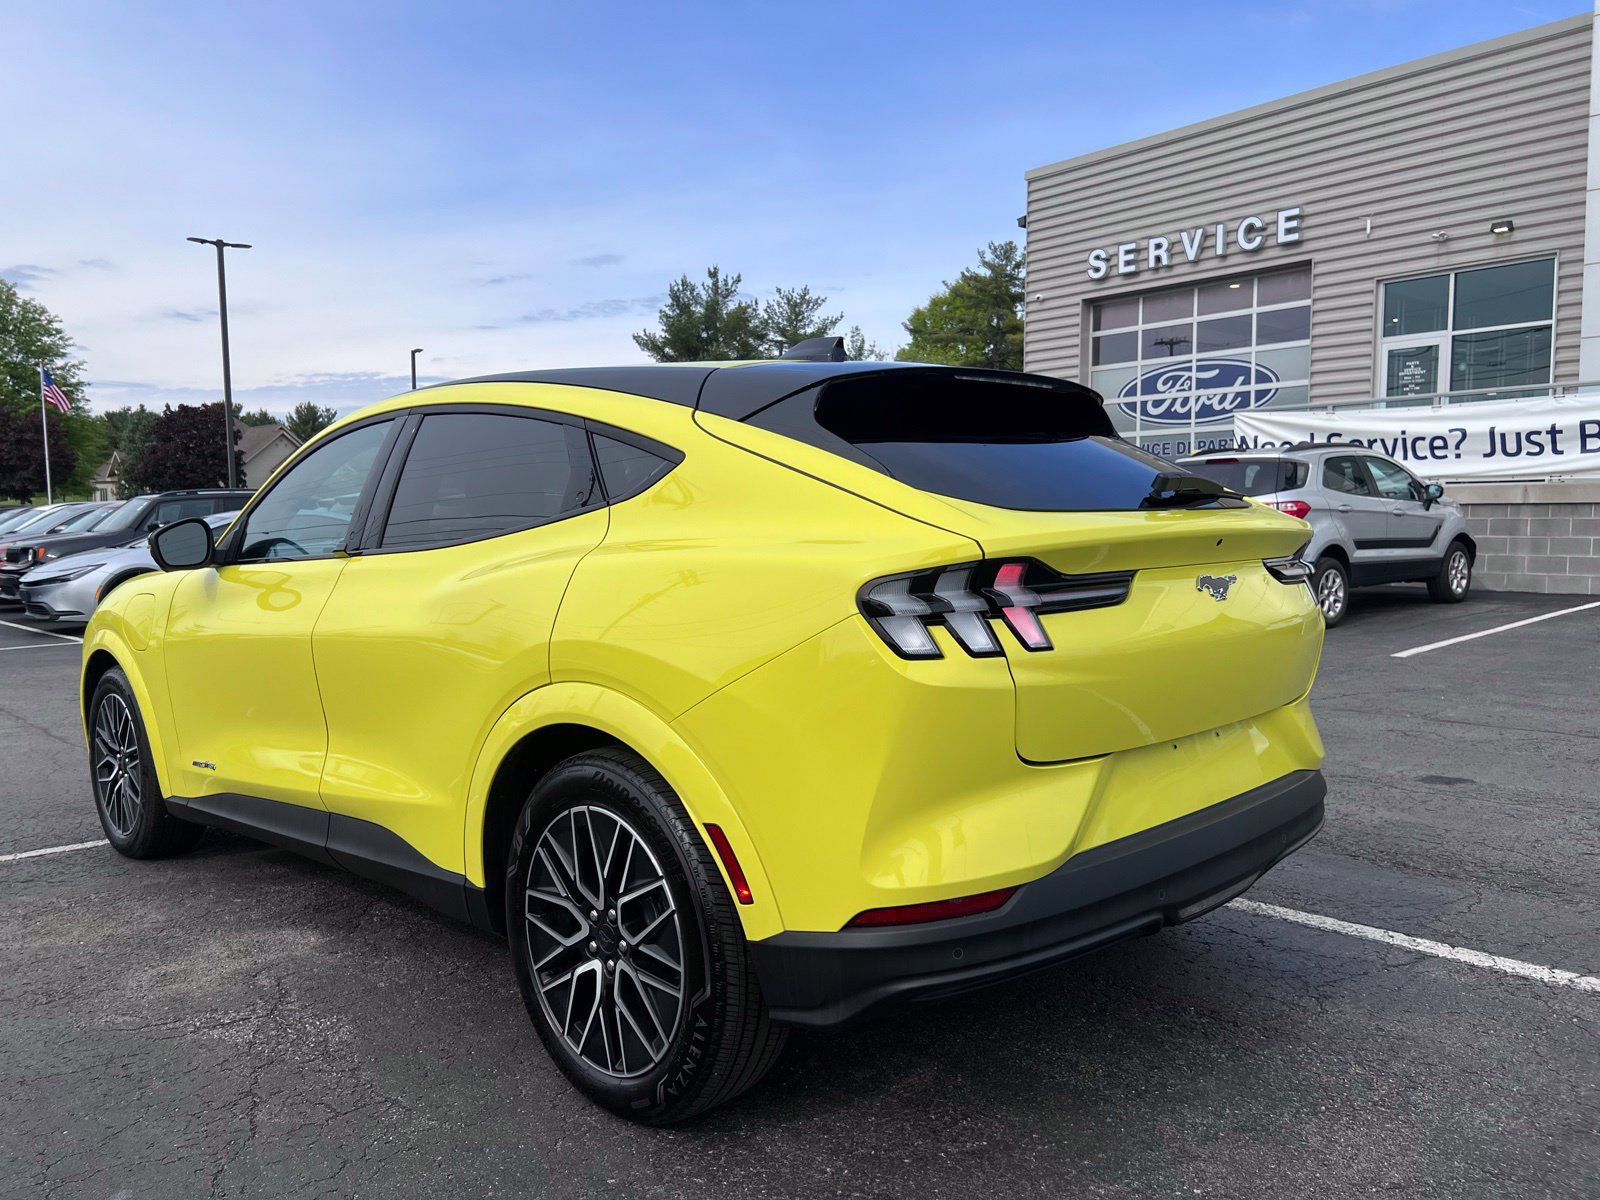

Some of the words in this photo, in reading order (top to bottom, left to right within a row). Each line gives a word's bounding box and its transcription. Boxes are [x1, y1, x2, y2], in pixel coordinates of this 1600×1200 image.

[1087, 207, 1301, 280] SERVICE
[1147, 369, 1245, 416] Ford
[1142, 442, 1171, 455] ICE
[1483, 423, 1564, 458] Just
[667, 1012, 708, 1096] ALENZA
